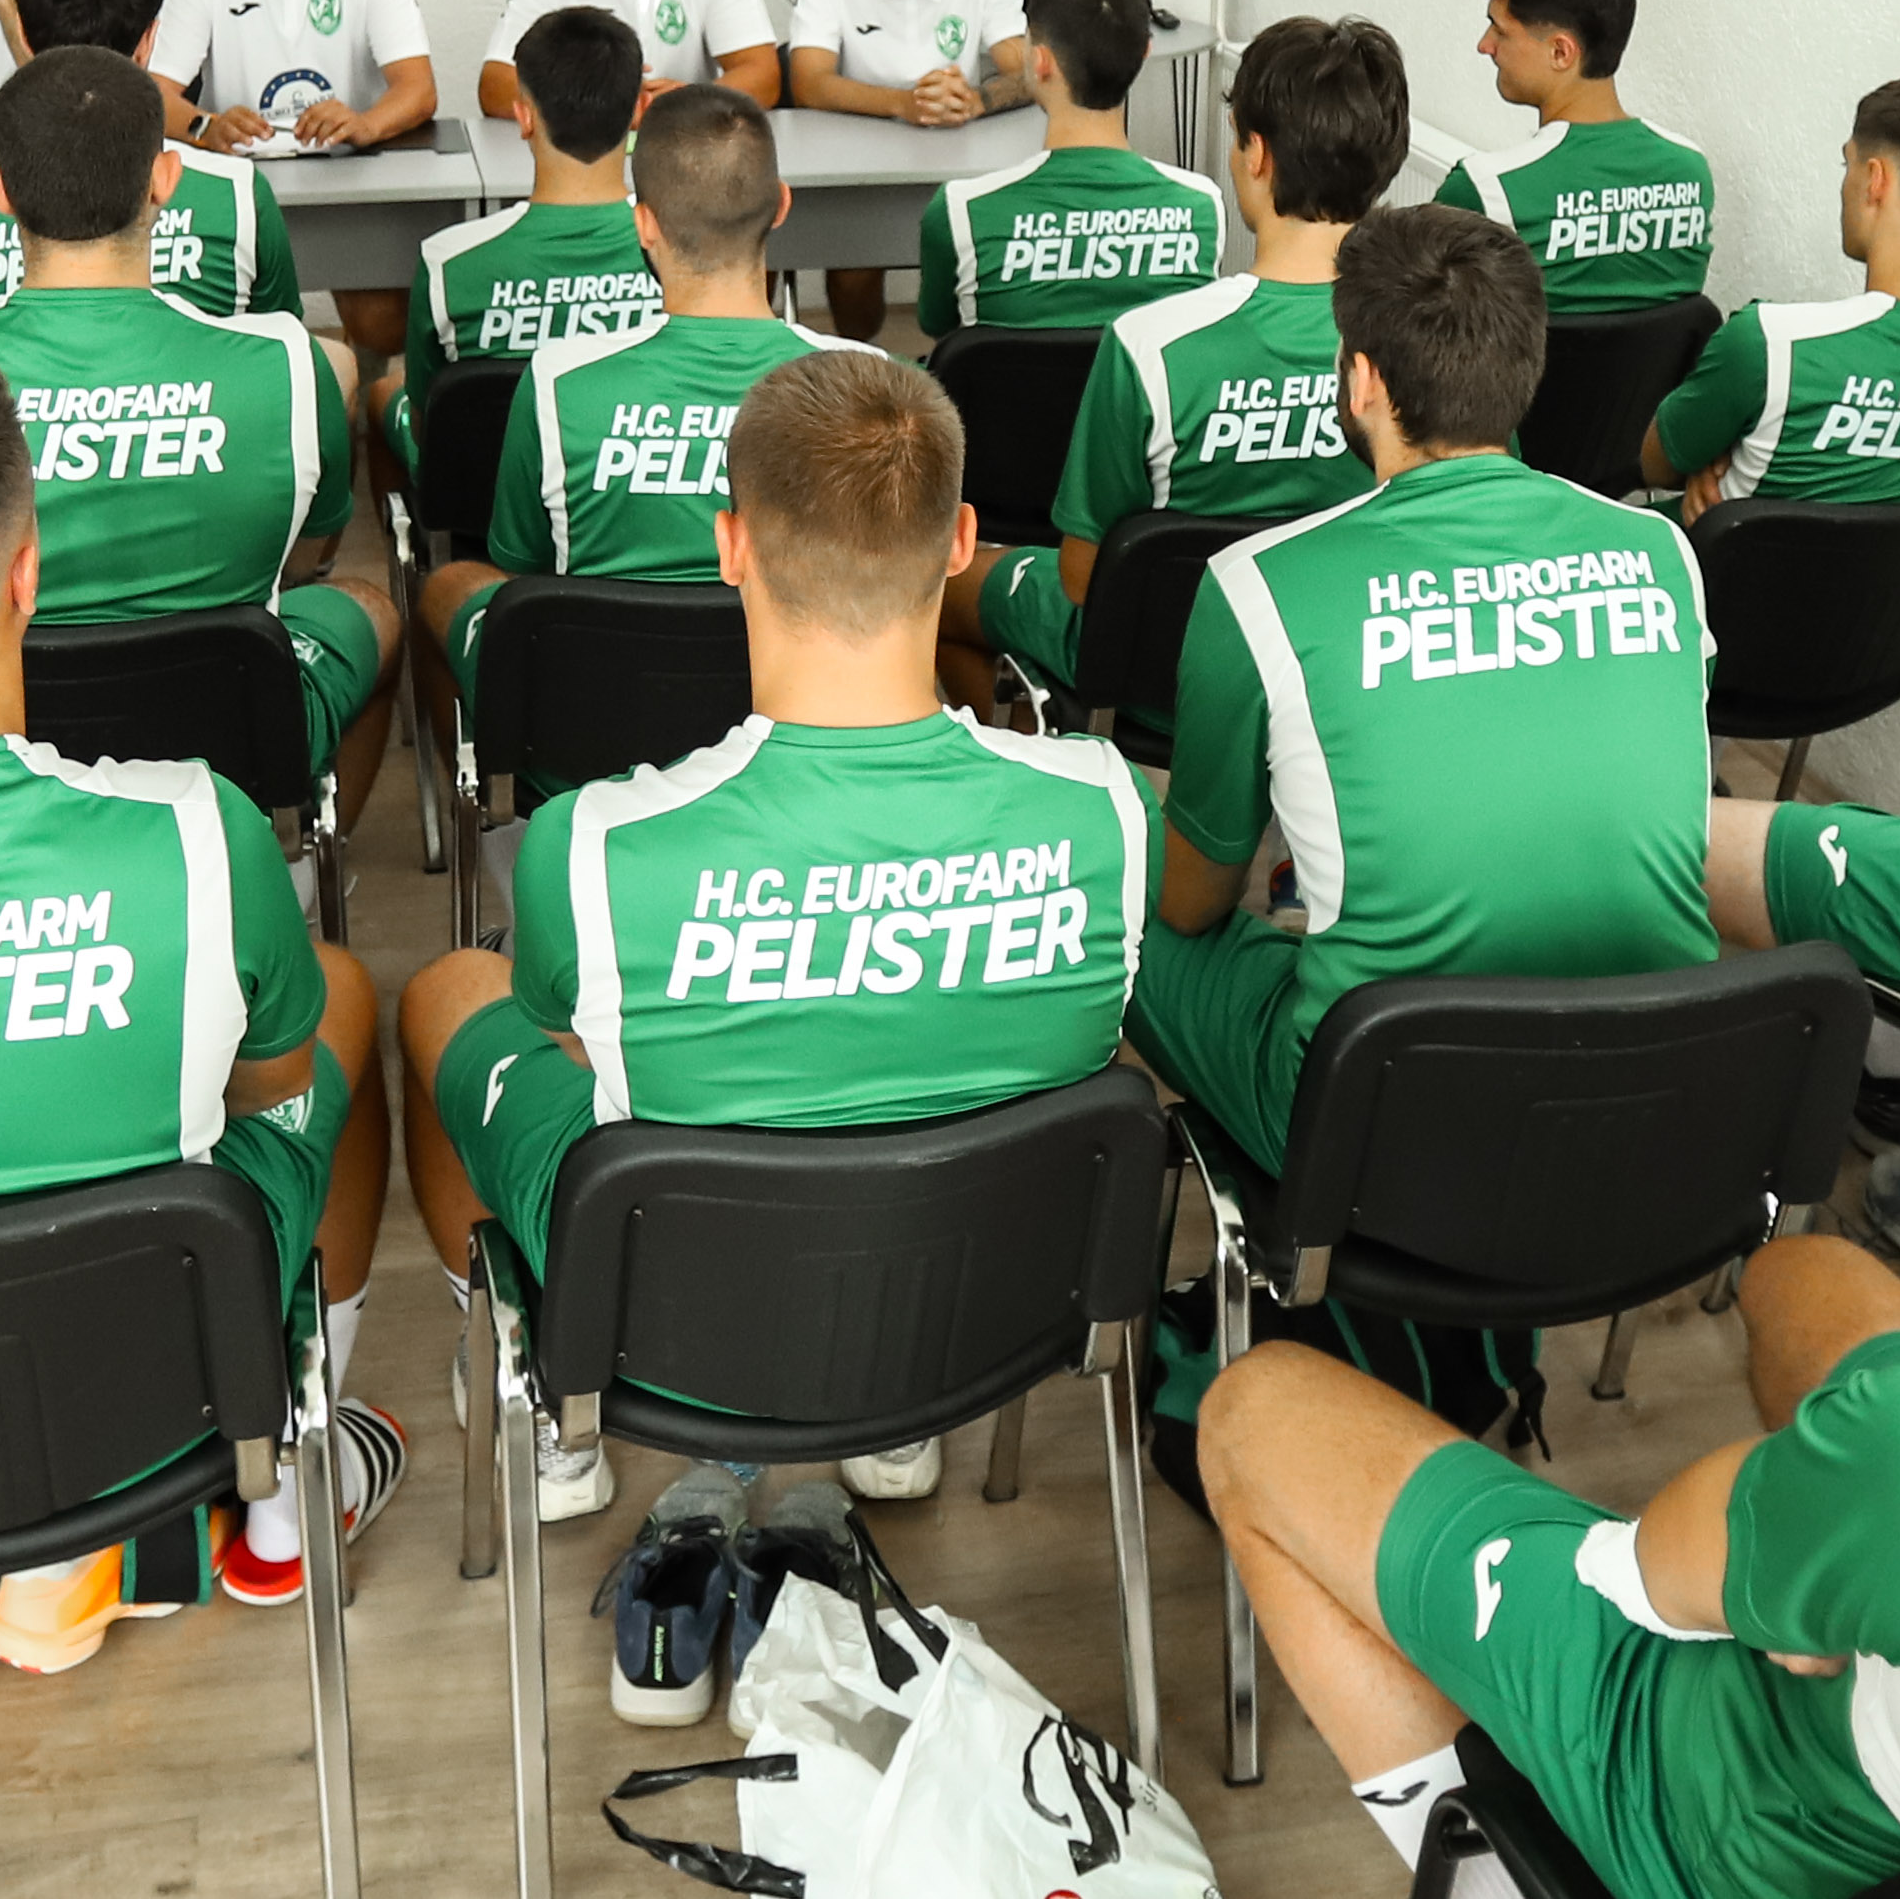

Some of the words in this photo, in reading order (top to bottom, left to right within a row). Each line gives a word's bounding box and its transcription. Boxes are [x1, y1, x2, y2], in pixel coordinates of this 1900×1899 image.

[1013, 213, 1063, 240] H.C.
[1064, 207, 1193, 237] EUROFARM
[1556, 190, 1600, 218] H.C.
[1601, 182, 1701, 213] EUROFARM
[1001, 232, 1201, 282] PELISTER
[1545, 206, 1706, 261] PELISTER
[491, 279, 542, 307] H.C.
[545, 271, 664, 304] EUROFA
[478, 298, 664, 351] PELIST
[17, 381, 213, 422] EUROFARM
[1218, 377, 1277, 411] H.C.
[1840, 375, 1898, 410] H.C.
[611, 403, 676, 438] H.C.
[1199, 405, 1349, 463] PELIS
[31, 415, 227, 482] ISTER
[592, 437, 732, 496] PELI
[1367, 572, 1450, 614] H.C.
[1452, 549, 1655, 606] EUROFARM
[1360, 586, 1682, 690] PELISTER
[693, 868, 794, 919] H.C.
[799, 838, 1073, 915] EUROFARM
[664, 888, 1090, 1003] PELISTER
